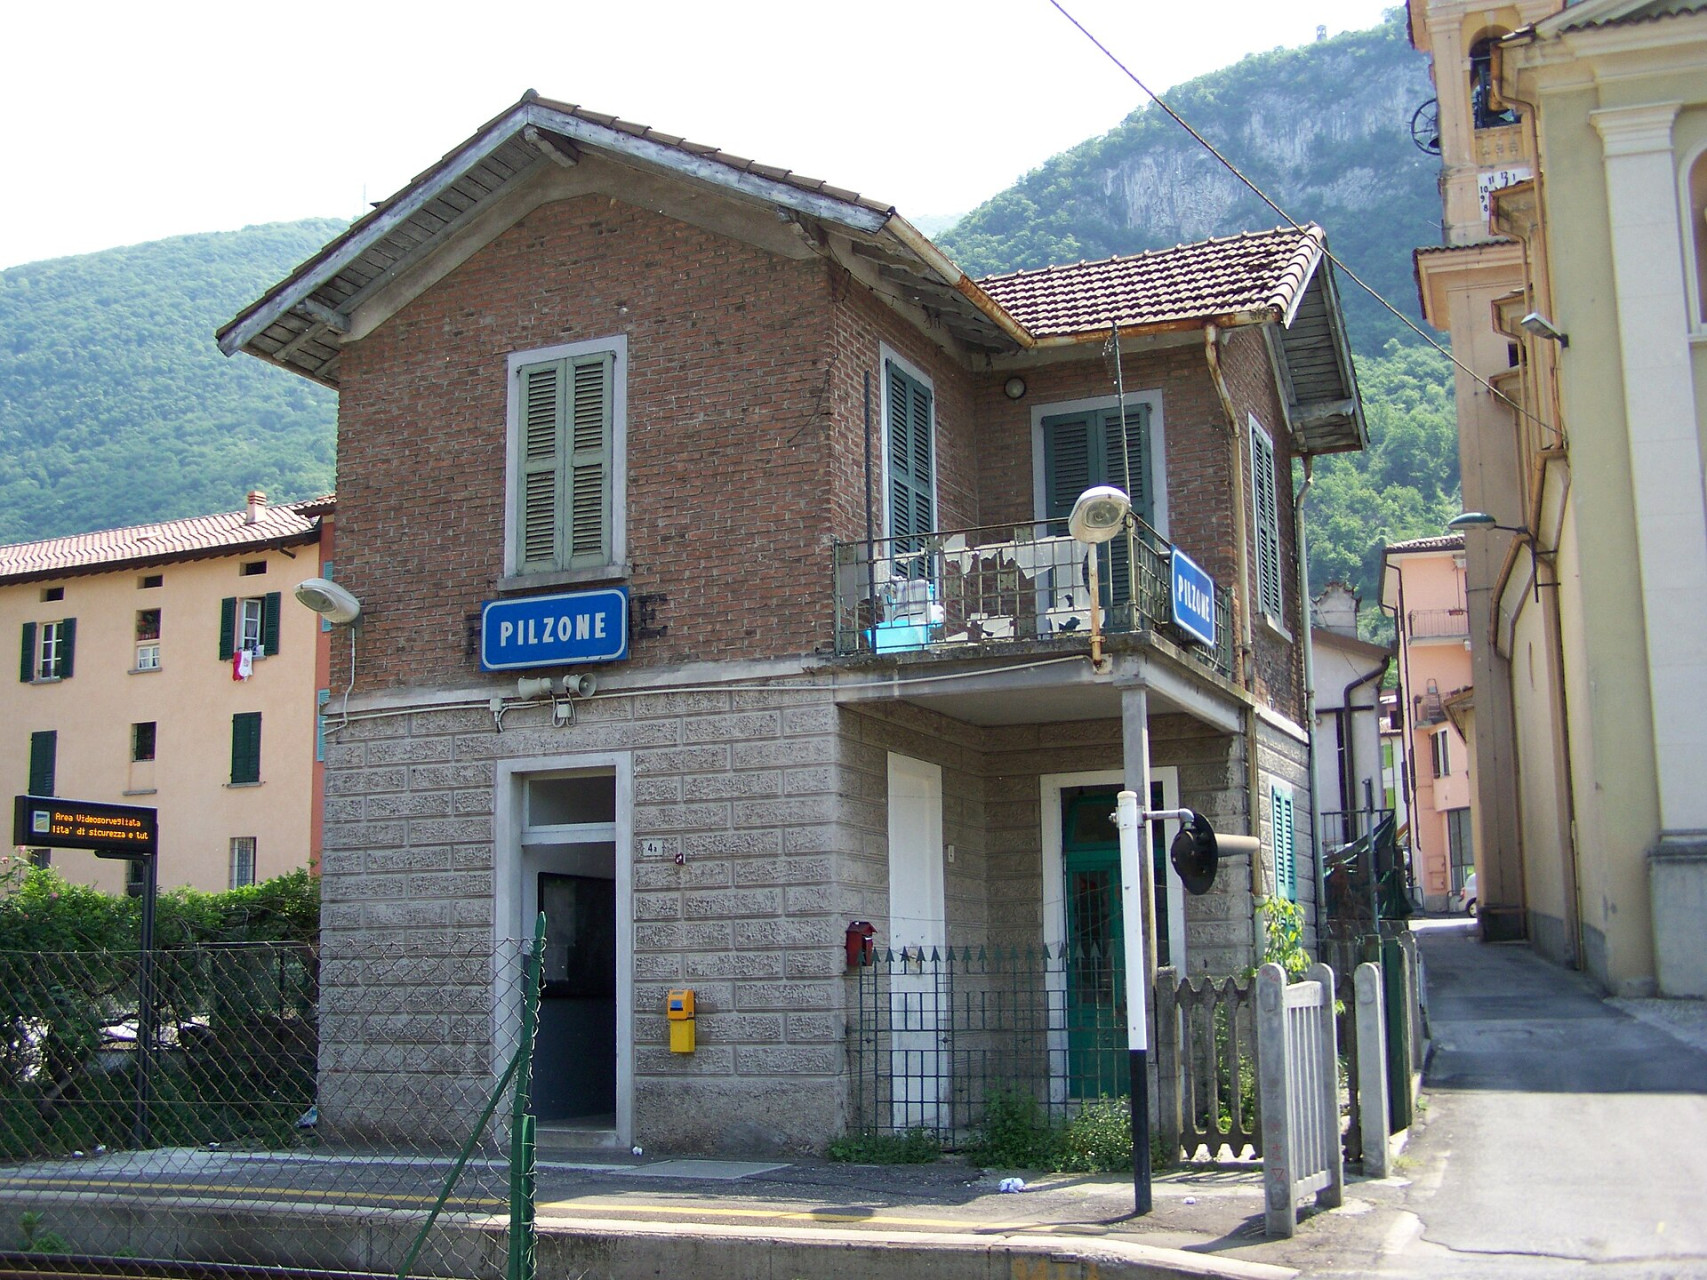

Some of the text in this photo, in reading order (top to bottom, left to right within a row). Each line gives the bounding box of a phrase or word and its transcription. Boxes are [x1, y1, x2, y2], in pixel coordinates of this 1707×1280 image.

[1488, 175, 1495, 185] 11
[1500, 171, 1508, 180] 12
[1480, 185, 1489, 194] 10
[1480, 194, 1485, 203] 9
[1483, 204, 1489, 212] 8
[1178, 574, 1210, 623] PILZONE
[500, 611, 607, 647] PILZONE
[55, 812, 142, 827] Area Videosorvegliata
[76, 827, 86, 836] di
[88, 827, 126, 838] sicurezza
[136, 831, 149, 840] tut
